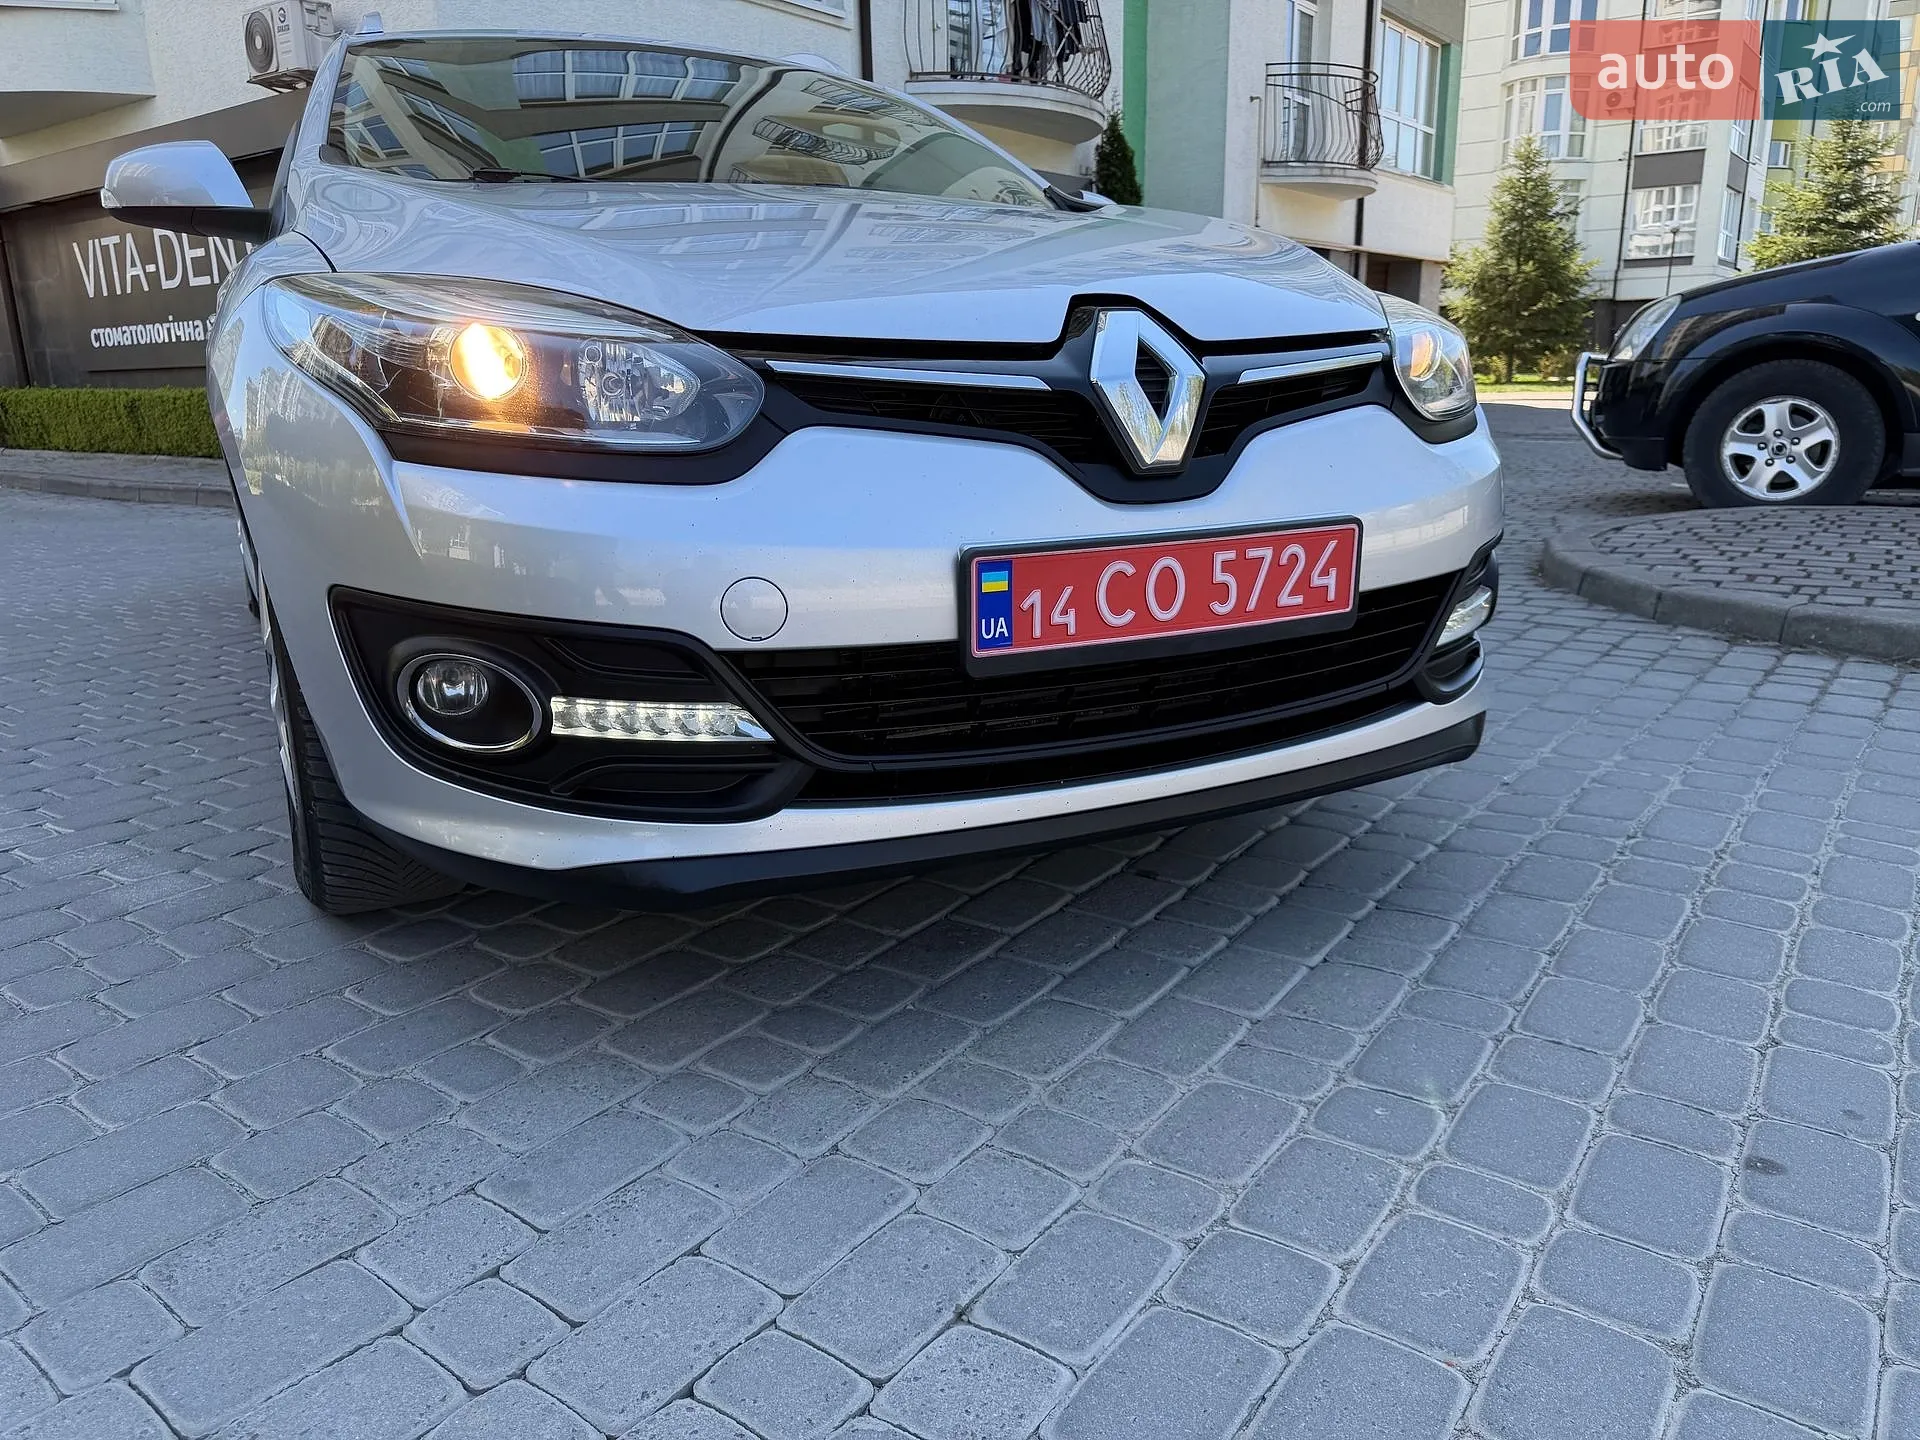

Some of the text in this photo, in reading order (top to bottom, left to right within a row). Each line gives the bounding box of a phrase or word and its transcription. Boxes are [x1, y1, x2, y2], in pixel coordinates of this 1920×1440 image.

[72, 228, 254, 298] VITA-DEN
[90, 315, 205, 348] стоматологічна
[1020, 539, 1339, 639] 14 CO 5724
[981, 617, 1009, 639] UA
